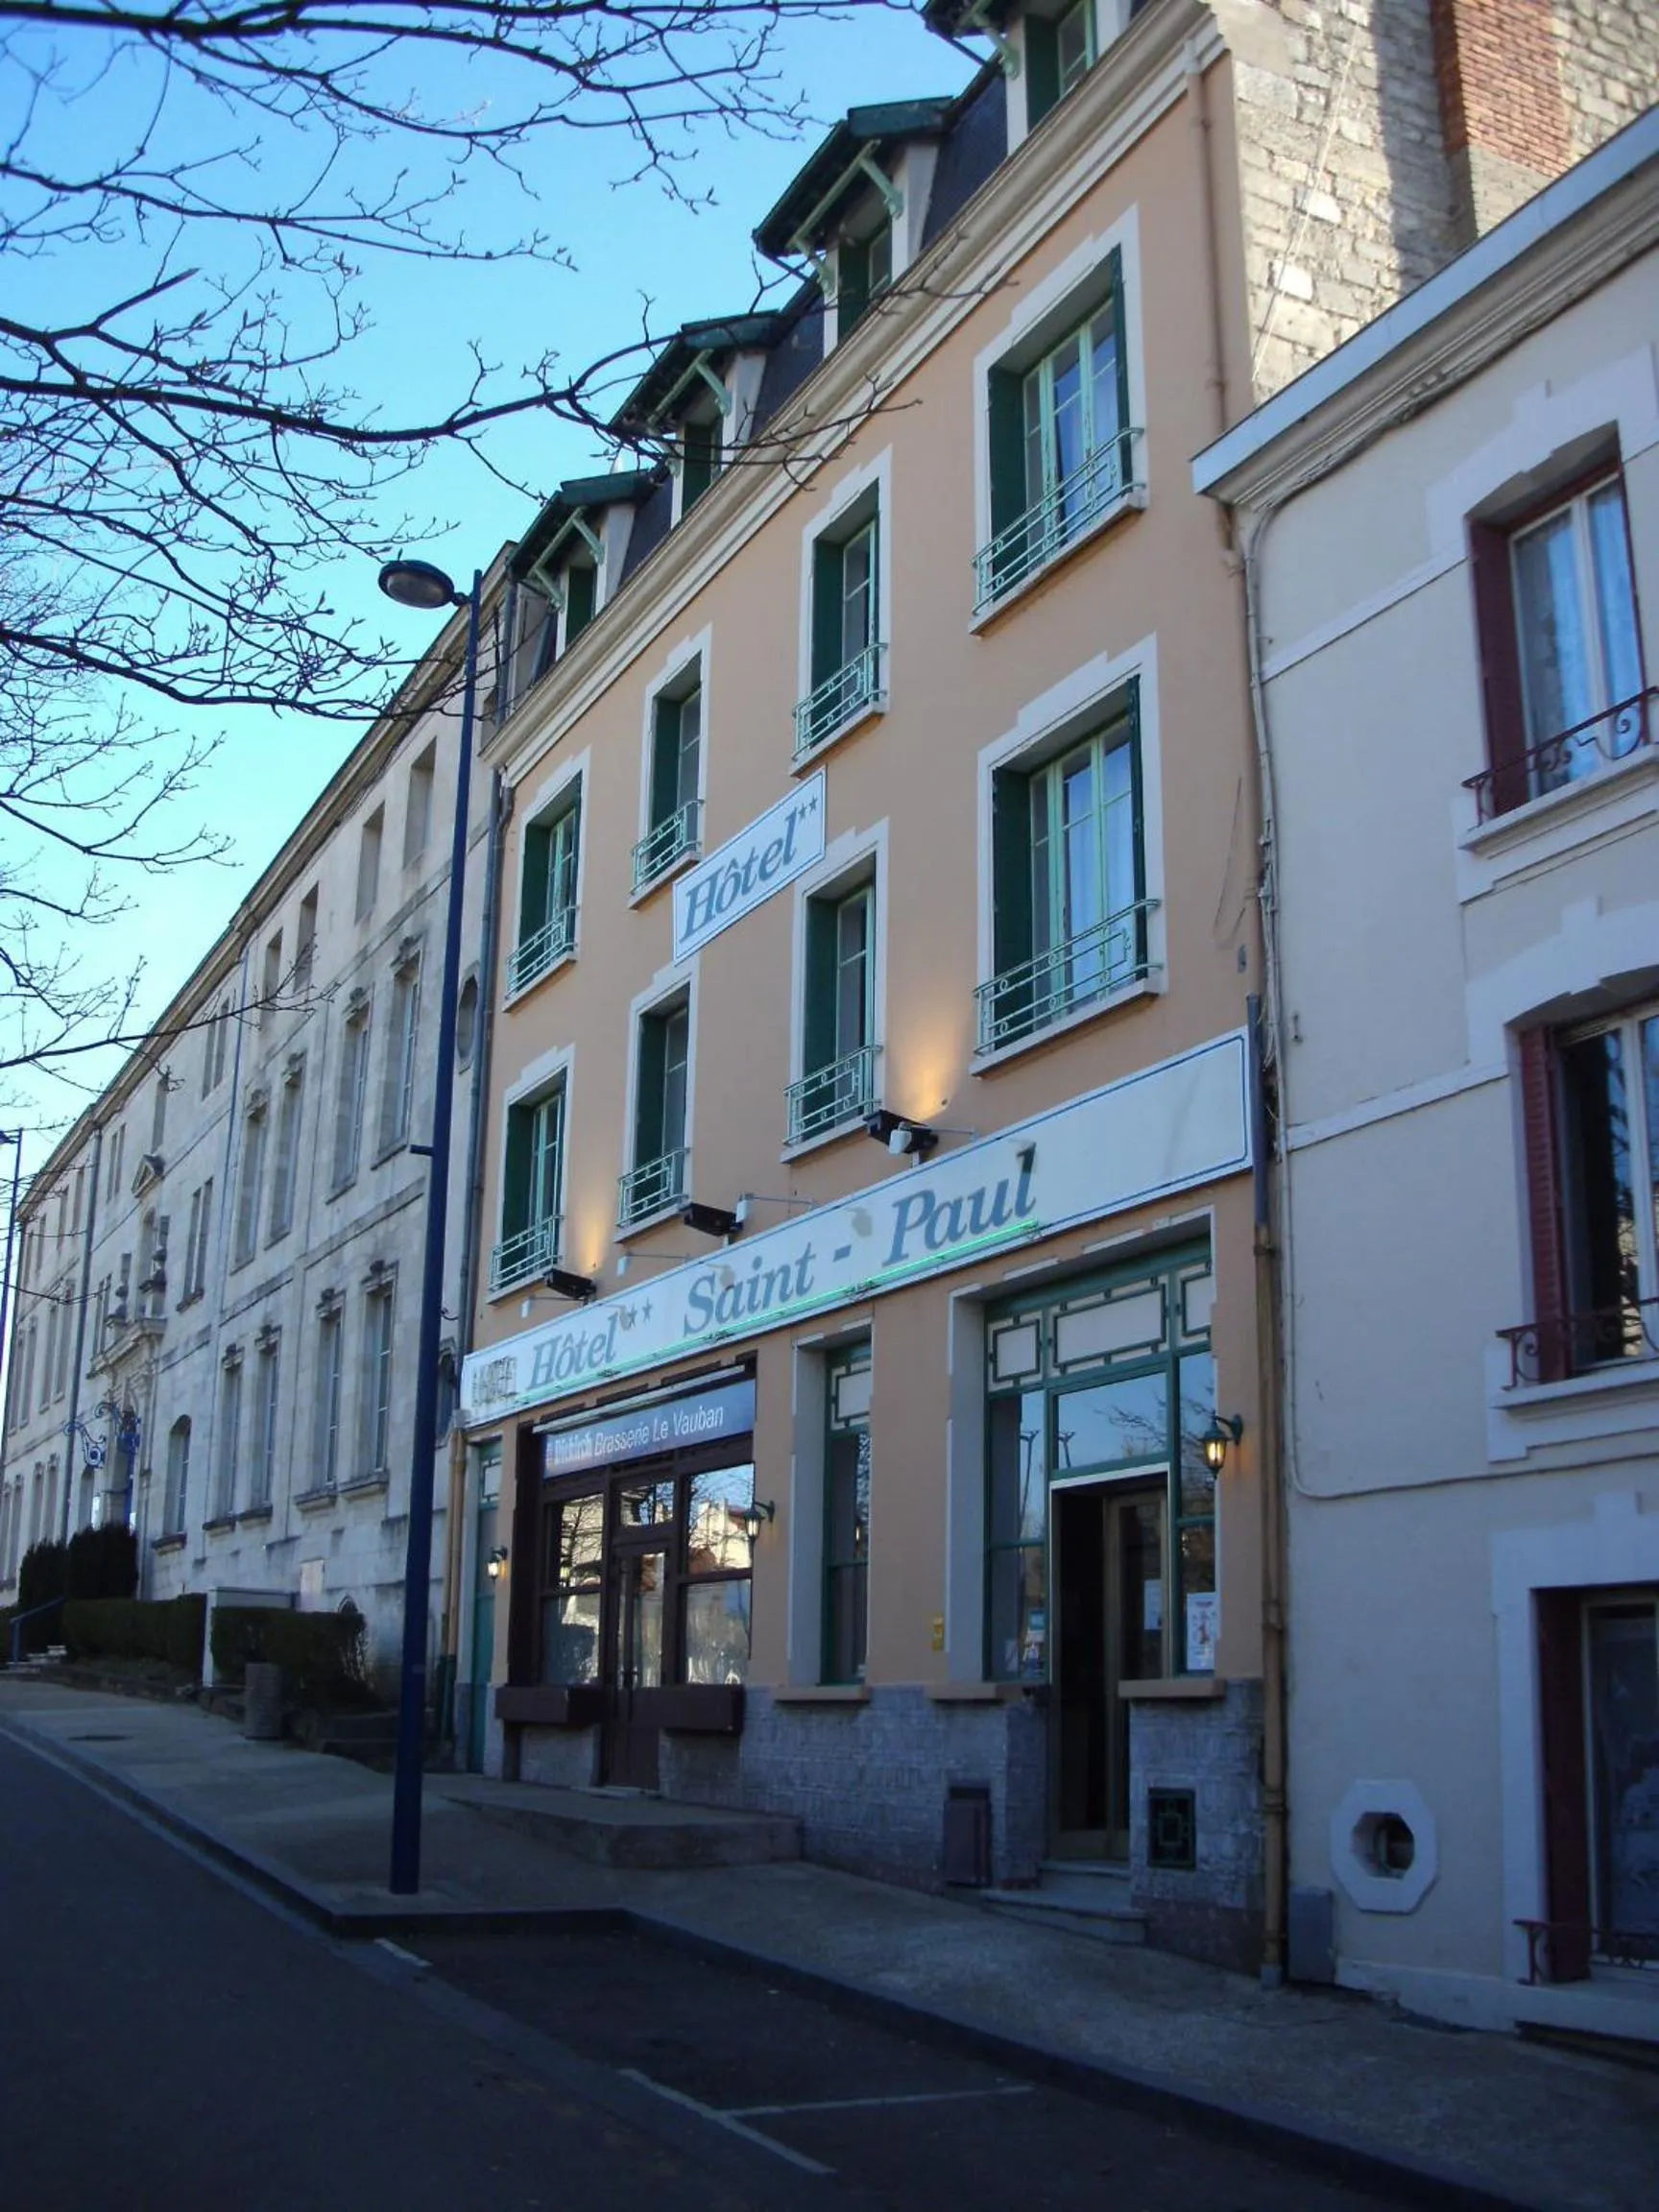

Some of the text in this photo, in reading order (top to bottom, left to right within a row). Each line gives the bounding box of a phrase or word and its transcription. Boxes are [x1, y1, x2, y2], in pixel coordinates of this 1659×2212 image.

[680, 808, 798, 942] Hôtel
[530, 1314, 617, 1389] Hôtel
[684, 1241, 816, 1335] Saint
[882, 1142, 1037, 1267] Paul
[595, 1422, 649, 1456] Brasserie
[653, 1416, 669, 1442] Le
[674, 1406, 723, 1436] Vauban
